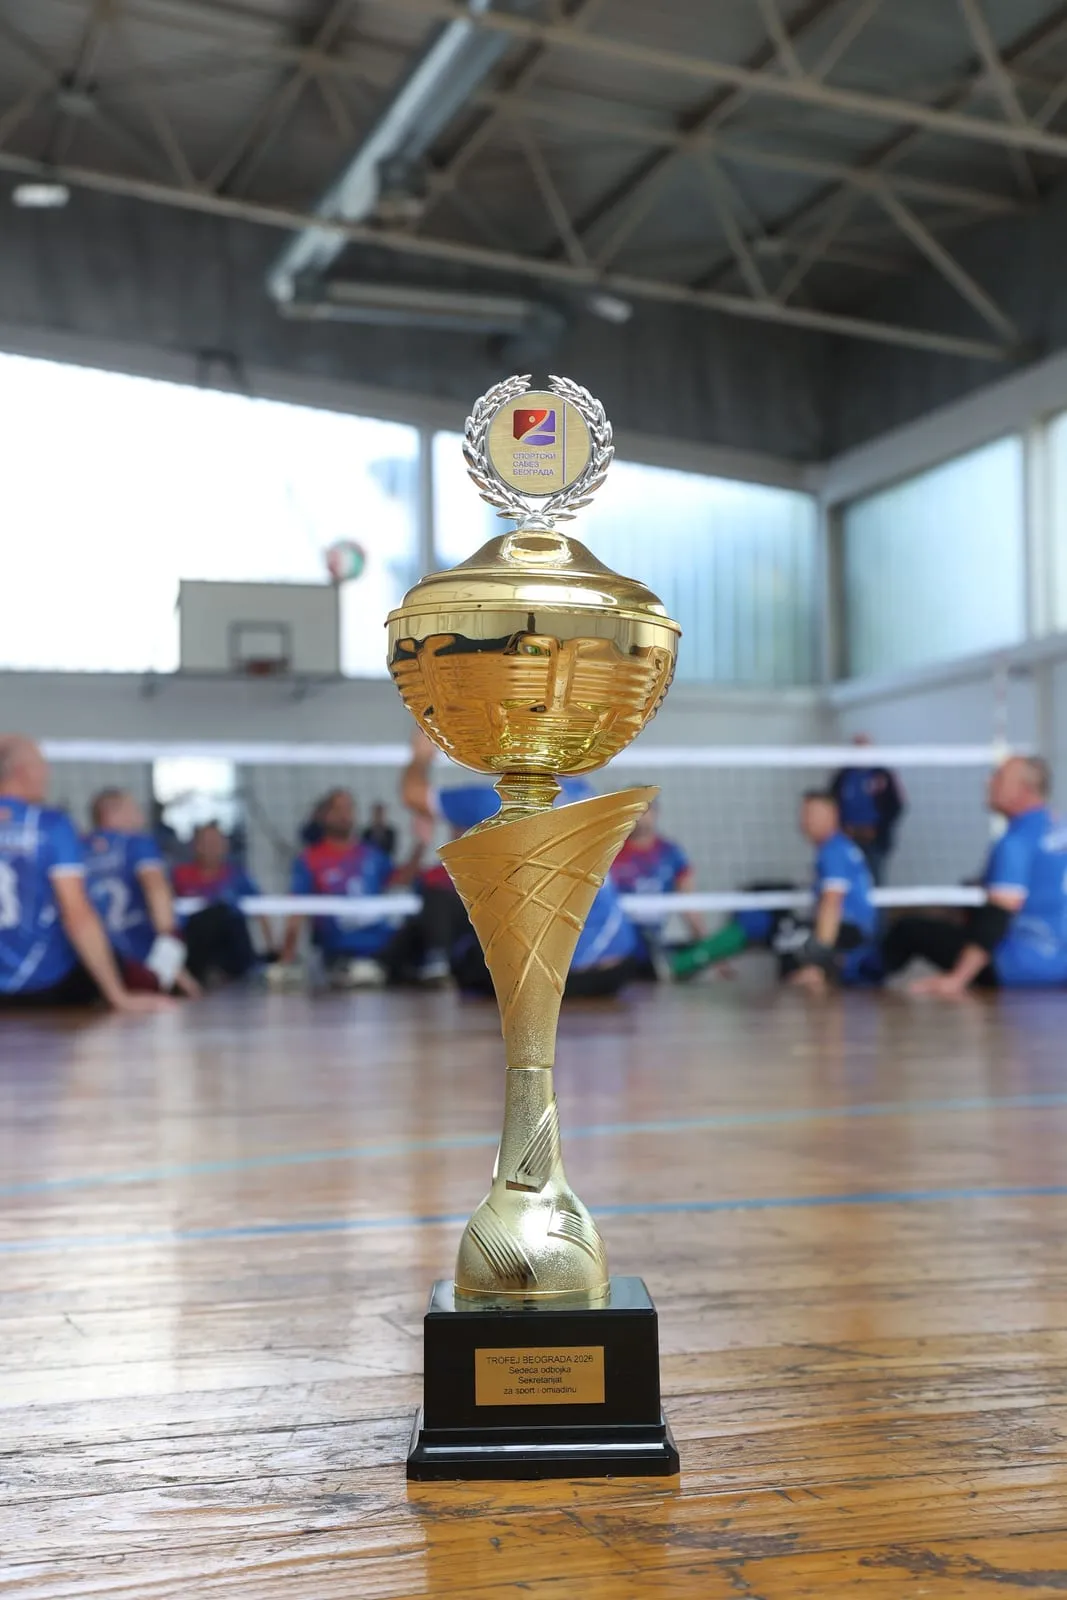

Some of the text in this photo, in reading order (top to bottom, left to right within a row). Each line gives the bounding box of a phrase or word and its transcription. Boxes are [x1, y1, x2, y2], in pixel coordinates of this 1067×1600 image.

[512, 452, 556, 460] СПОРТСКИ
[512, 460, 540, 468] САВЕЗ
[512, 468, 554, 476] БЕОГРАДА
[486, 1356, 520, 1365] TROFEJ
[523, 1355, 572, 1364] BEOGRADA
[540, 1366, 572, 1376] odbojka
[503, 1387, 513, 1395] za
[515, 1387, 536, 1396] sport
[541, 1386, 577, 1394] omladinu
